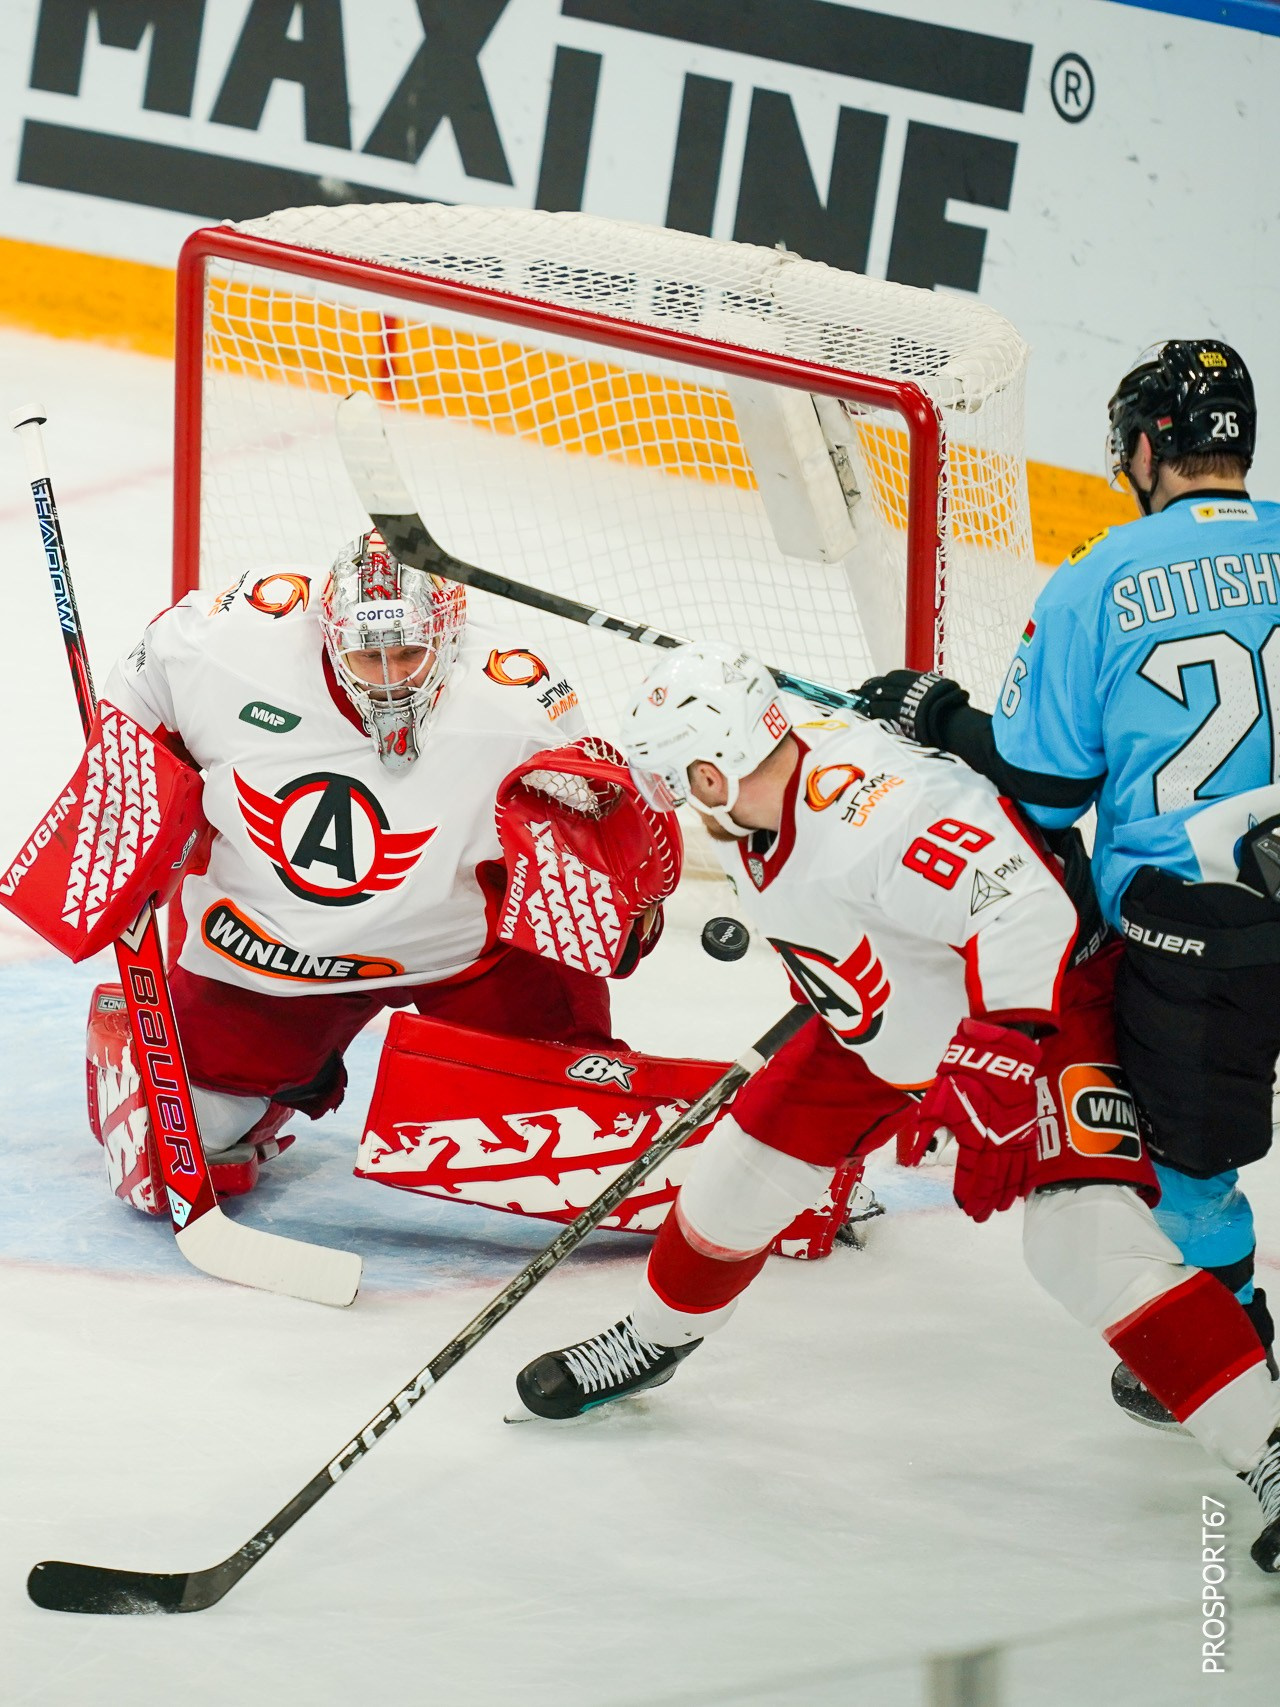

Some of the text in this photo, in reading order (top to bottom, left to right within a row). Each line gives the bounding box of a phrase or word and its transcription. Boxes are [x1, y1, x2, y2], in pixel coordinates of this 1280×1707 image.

[1210, 411, 1240, 438] 26
[1112, 552, 1280, 633] SOTISH
[356, 607, 405, 622] согаз
[587, 609, 694, 651] CC
[536, 679, 574, 709] УГМК
[250, 705, 286, 727] МИР
[762, 703, 788, 740] 89
[1136, 625, 1280, 816] 2
[384, 726, 409, 756] 18
[902, 818, 996, 891] 89
[500, 852, 529, 939] VAUGHN
[210, 912, 355, 977] WINLINE
[1121, 915, 1206, 957] BAUER
[128, 965, 197, 1175] BAUER
[942, 1044, 1036, 1085] AUER
[328, 1368, 435, 1482] CCM
